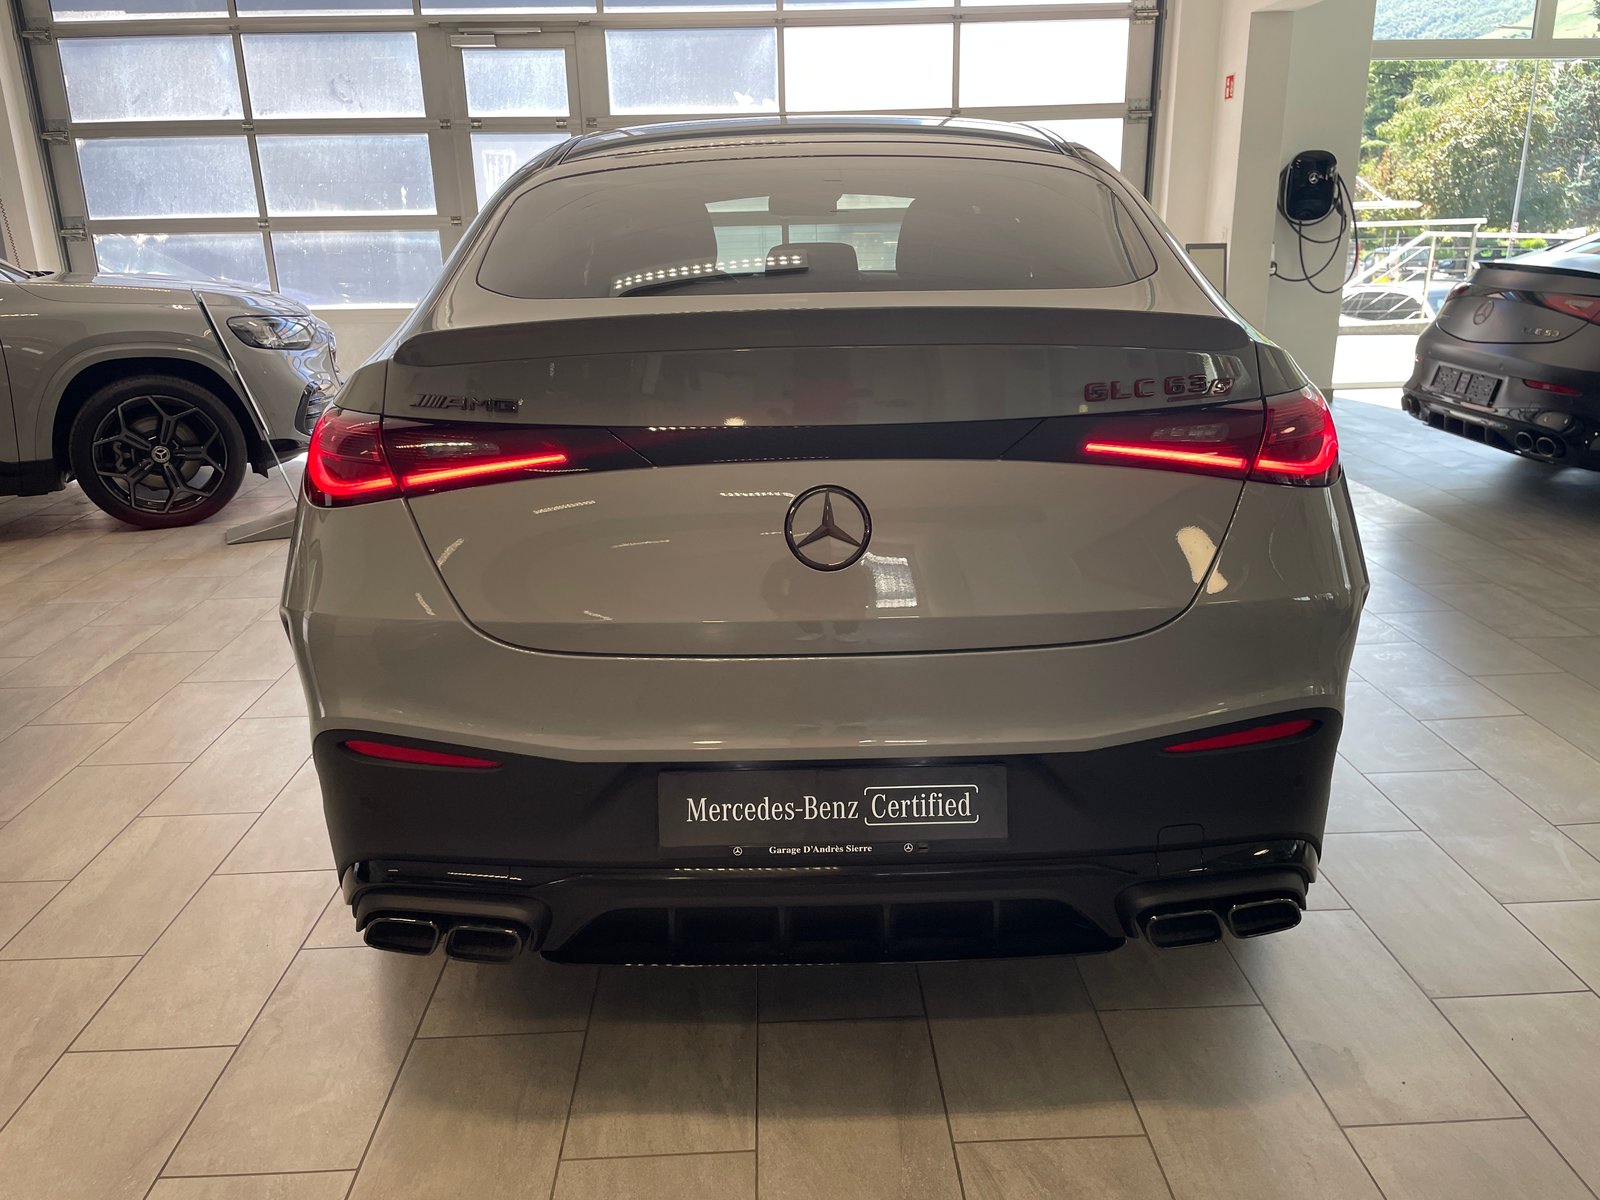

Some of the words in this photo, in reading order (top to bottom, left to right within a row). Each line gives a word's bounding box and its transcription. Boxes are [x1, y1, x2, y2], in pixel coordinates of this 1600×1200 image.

[1084, 379, 1156, 402] GLC
[686, 795, 859, 822] Mercedes-Benz
[871, 792, 972, 819] Certified
[769, 846, 801, 855] Garage
[803, 845, 844, 854] D'Andrès
[845, 844, 873, 853] Sierre
